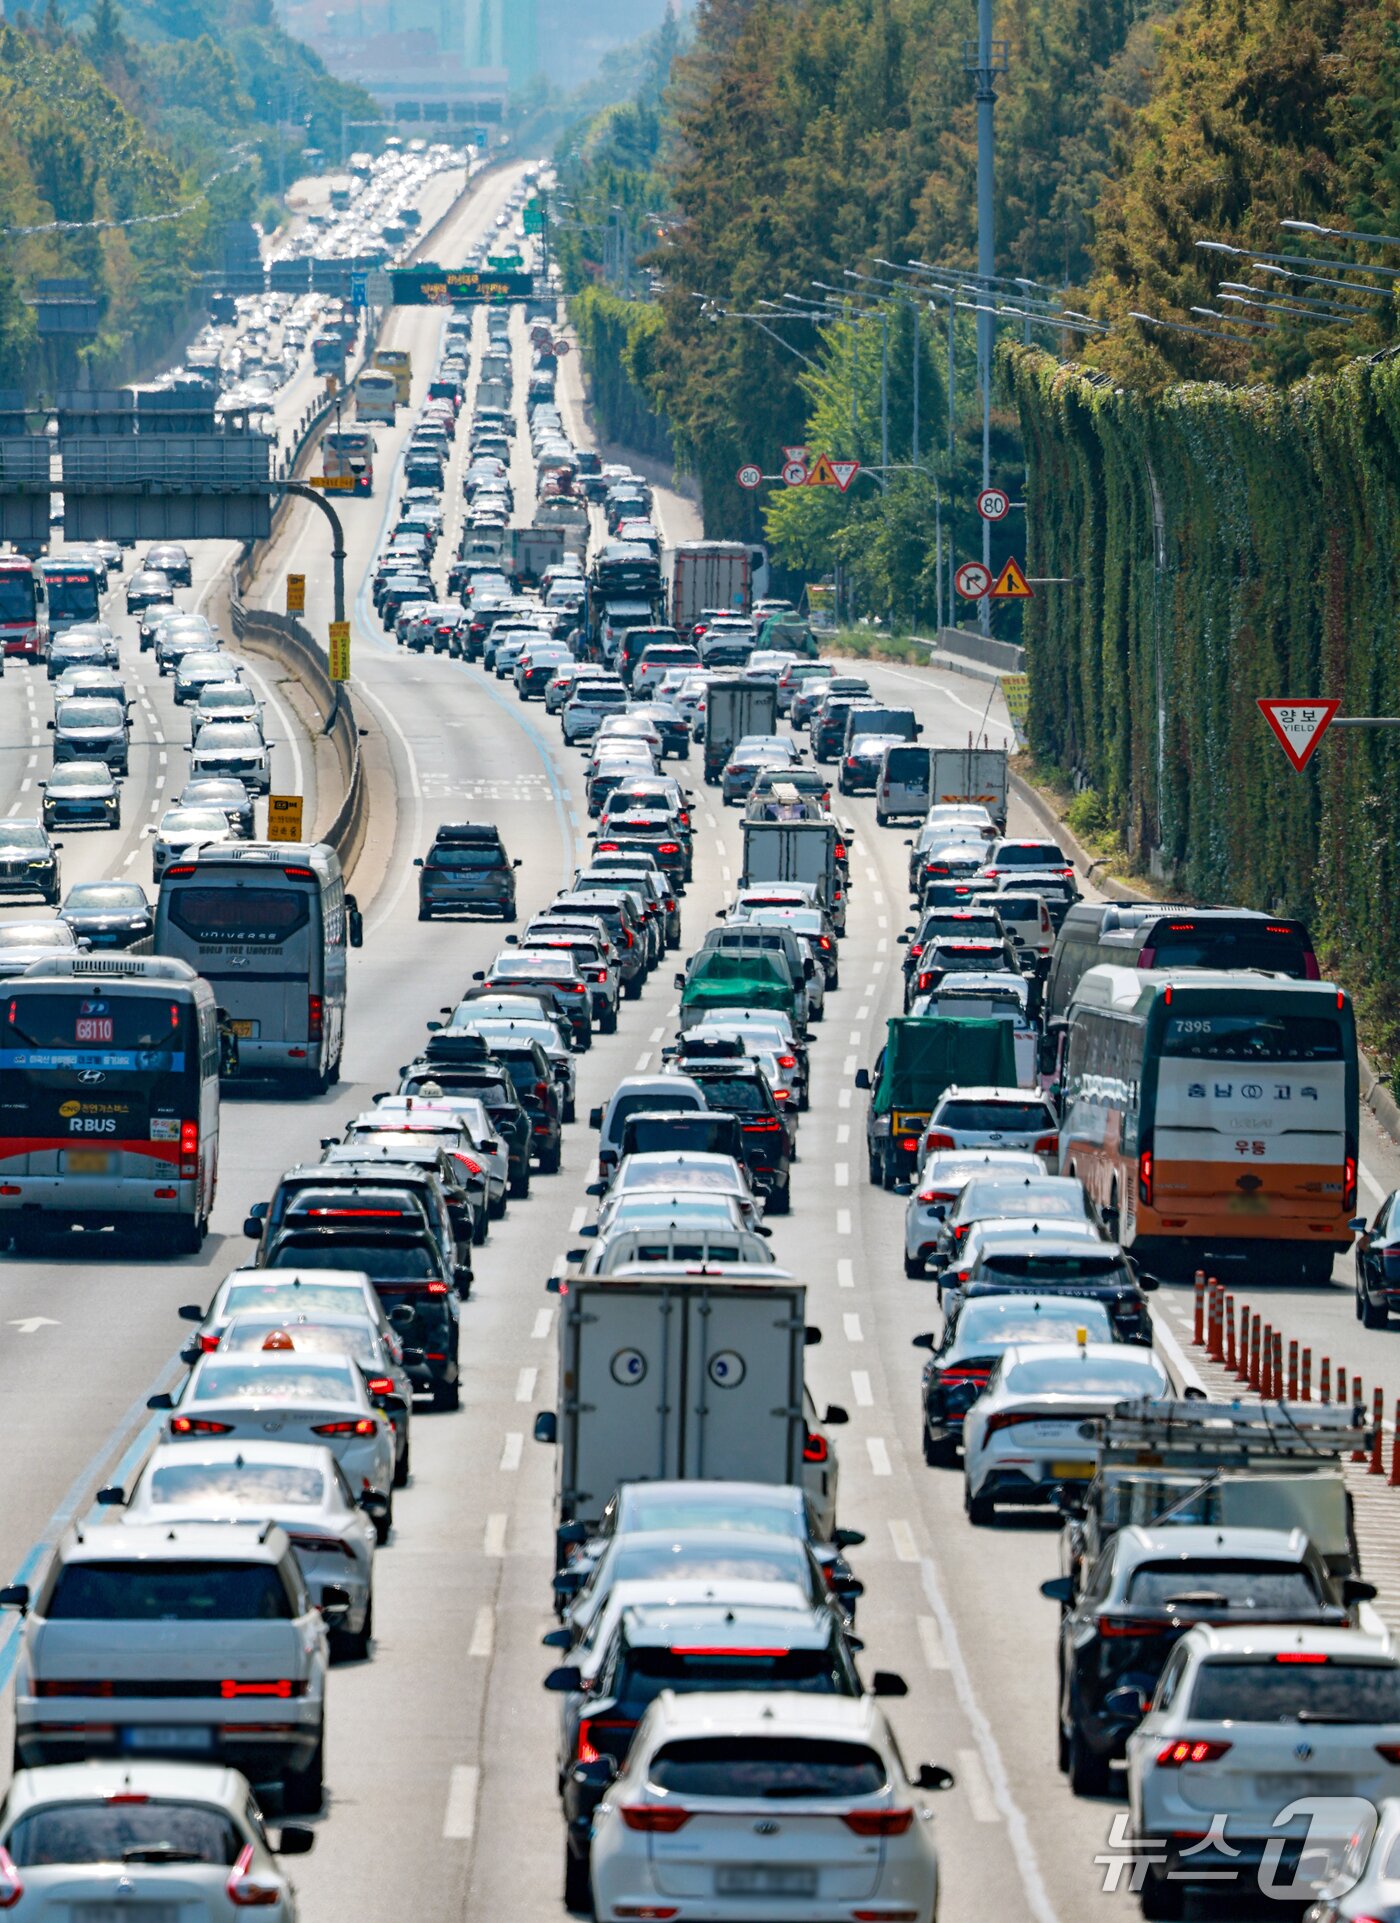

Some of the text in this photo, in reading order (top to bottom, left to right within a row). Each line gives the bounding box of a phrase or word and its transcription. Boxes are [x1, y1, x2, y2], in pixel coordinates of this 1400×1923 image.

[742, 471, 758, 483] 80
[983, 497, 1004, 514] 80
[1282, 724, 1315, 732] YIELD
[200, 932, 277, 940] UNIVERSE
[76, 1020, 111, 1039] G8110
[1175, 1021, 1212, 1033] 7395
[1234, 1139, 1267, 1156] 우등
